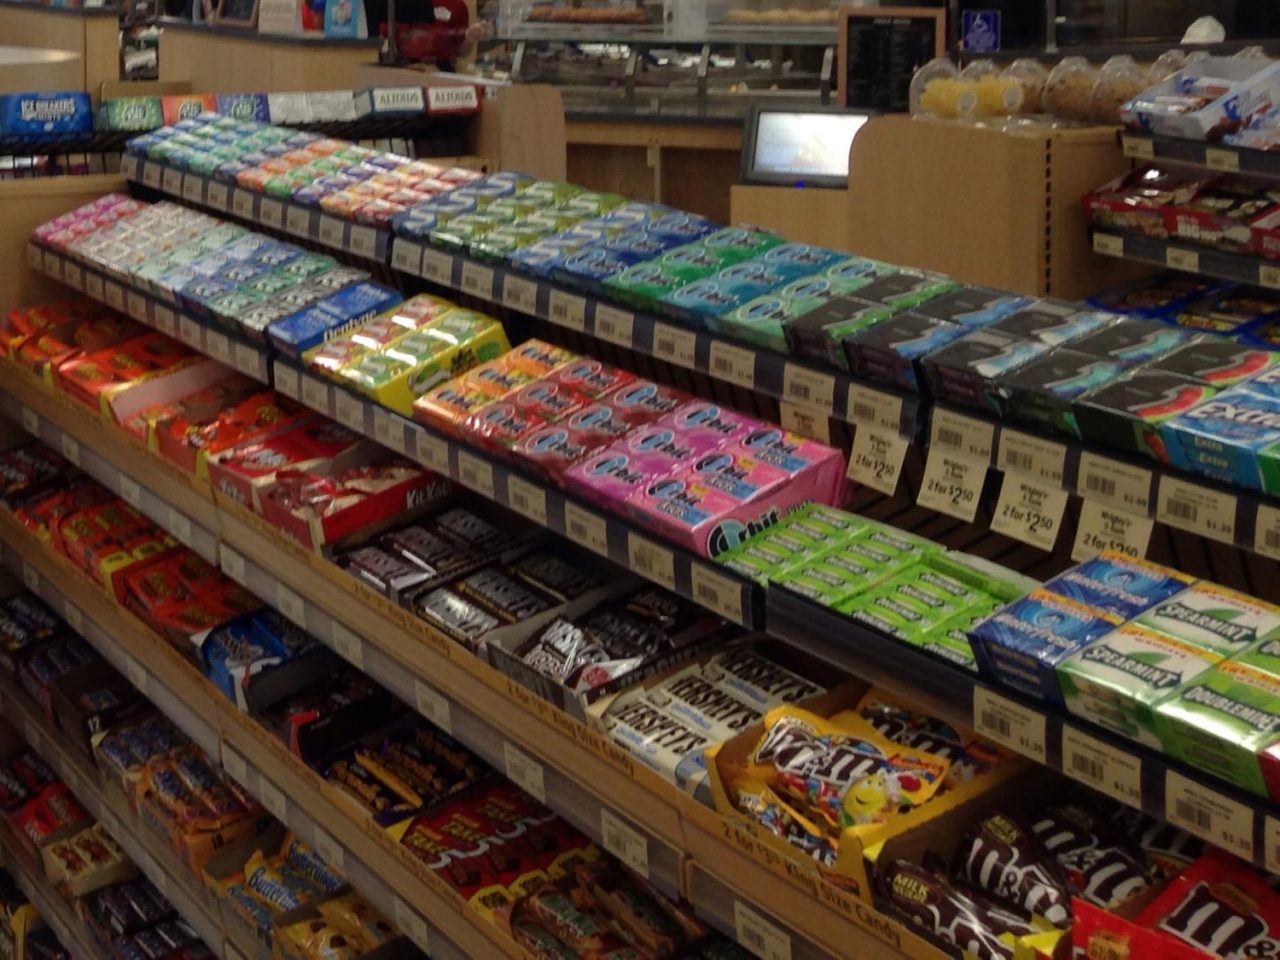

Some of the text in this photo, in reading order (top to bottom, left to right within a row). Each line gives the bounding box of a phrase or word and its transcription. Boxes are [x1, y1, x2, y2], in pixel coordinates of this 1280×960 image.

[630, 427, 694, 459] Orbit
[584, 452, 644, 484] Orbit
[862, 456, 872, 468] for
[934, 482, 949, 495] for
[1002, 505, 1008, 517] 2
[1009, 505, 1024, 522] for
[708, 506, 780, 561] Orbit
[1083, 533, 1090, 545] 2
[1091, 534, 1107, 552] for
[1160, 602, 1253, 642] SPEARMINT
[1085, 646, 1178, 688] SPEARMINT
[894, 874, 929, 896] MILK
[784, 859, 819, 897] King
[821, 881, 851, 914] Size
[855, 901, 901, 948] Candy
